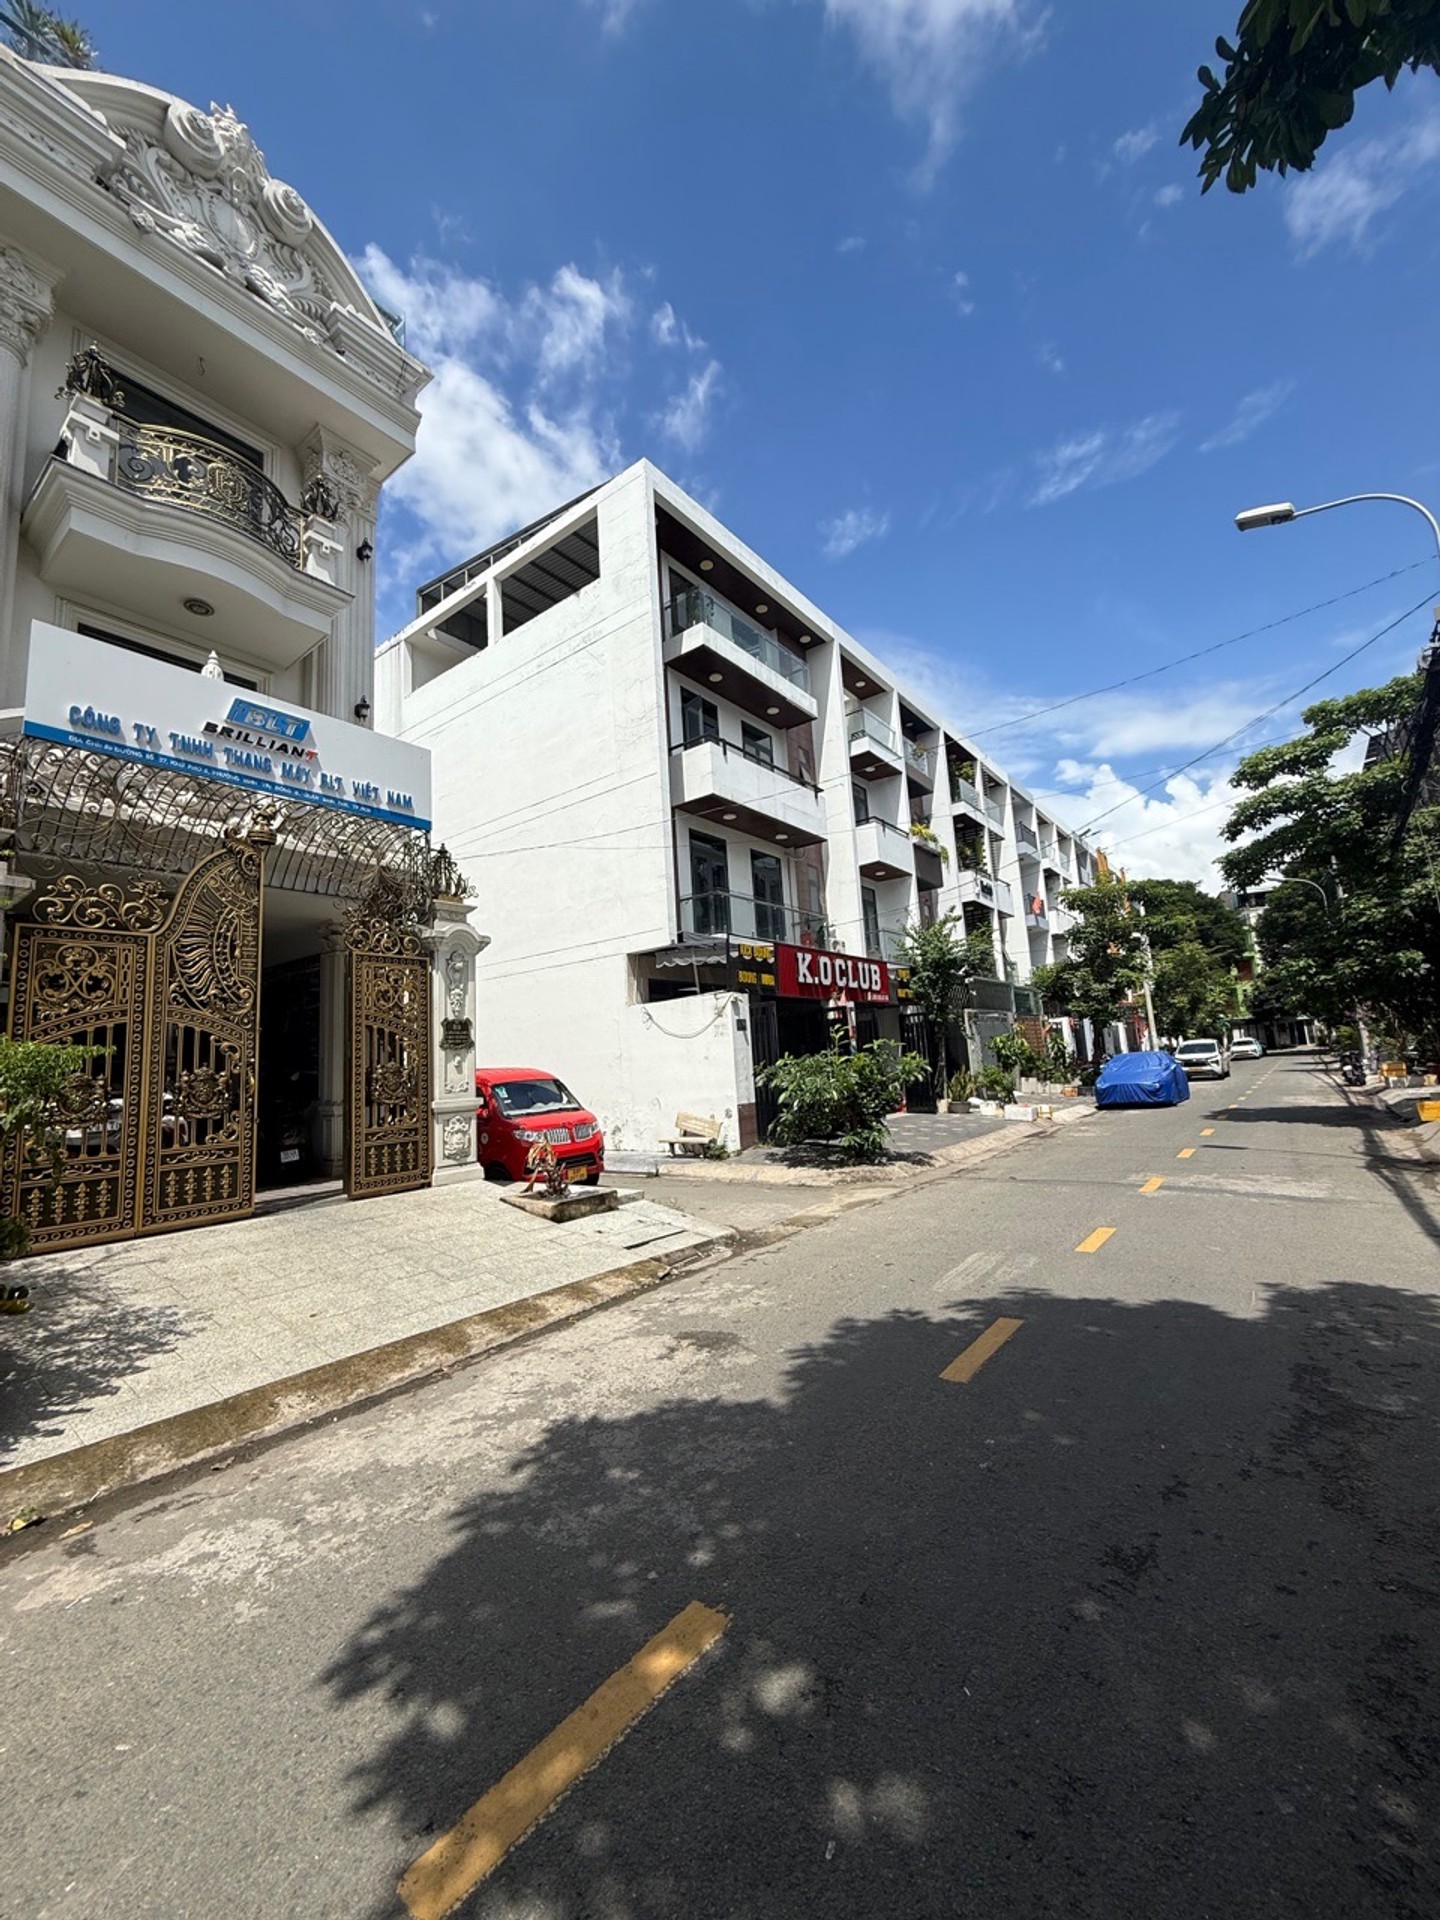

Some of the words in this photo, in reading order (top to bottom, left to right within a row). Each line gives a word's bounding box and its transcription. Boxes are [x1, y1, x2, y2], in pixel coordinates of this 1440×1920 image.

[69, 705, 121, 735] CÔNG
[133, 722, 156, 744] TY
[169, 732, 213, 759] TNHH
[224, 747, 272, 772] THANG
[281, 761, 311, 784] MÁY
[320, 772, 343, 790] BLT
[352, 780, 379, 801] VIỆT
[386, 790, 413, 808] NAM
[202, 721, 318, 760] BRILLIANT
